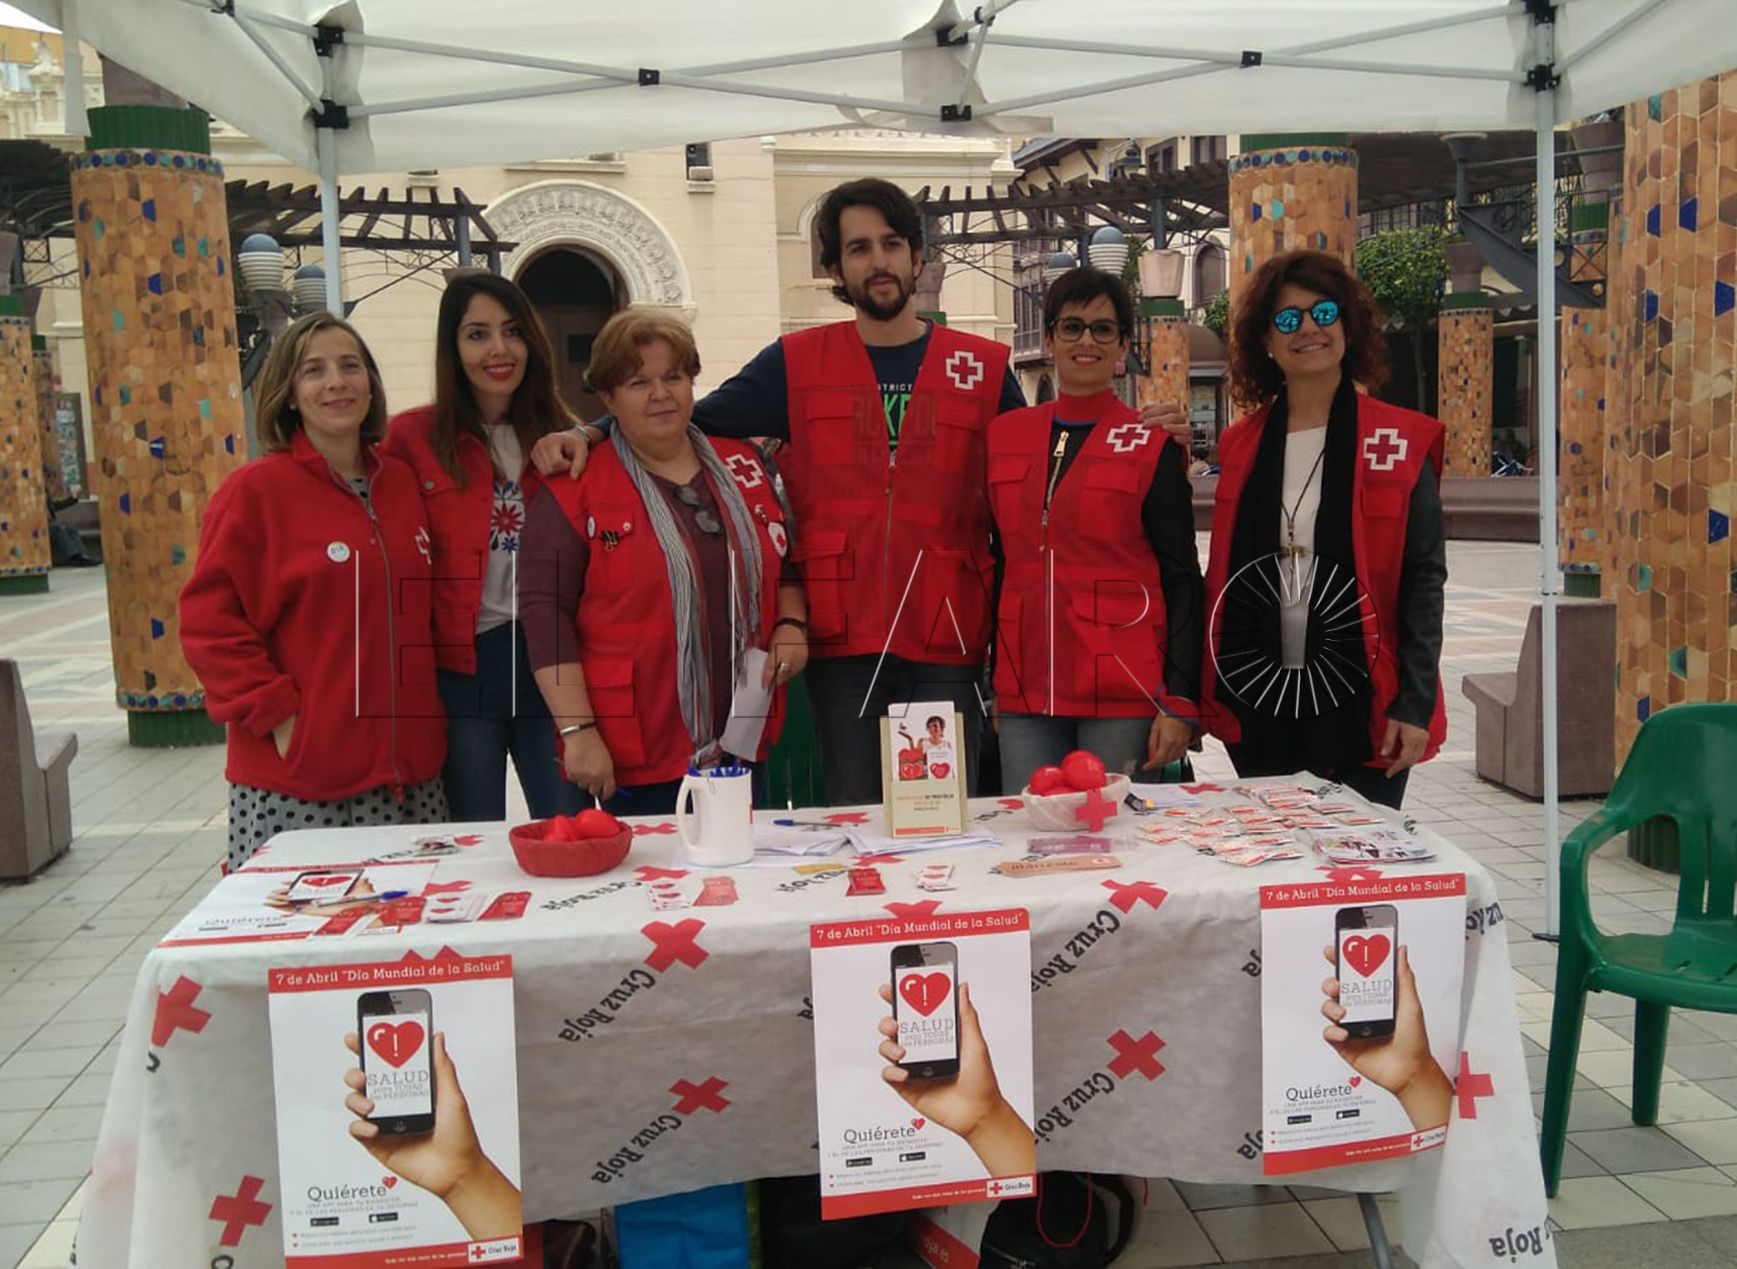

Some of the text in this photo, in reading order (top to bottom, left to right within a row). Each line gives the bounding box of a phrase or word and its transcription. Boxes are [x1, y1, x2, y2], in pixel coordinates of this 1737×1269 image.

[1266, 890, 1274, 901] 7
[1276, 890, 1290, 901] de
[1292, 887, 1319, 900] Abril
[1348, 882, 1393, 896] Mundial
[1395, 883, 1408, 893] de
[1411, 881, 1422, 892] la
[816, 928, 824, 940] 7
[827, 928, 842, 940] de
[844, 925, 873, 939] Abril
[904, 919, 951, 934] Mundial
[954, 919, 968, 929] de
[971, 917, 983, 928] la
[1063, 909, 1121, 959] Cruz
[275, 973, 285, 986] 7
[287, 974, 304, 985] de
[306, 971, 338, 984] Abril
[373, 963, 425, 980] Mundial
[429, 964, 444, 976] de
[448, 963, 460, 975] la
[1341, 978, 1393, 994] SALUD
[558, 968, 657, 1042] Cruz Roja
[900, 1018, 954, 1034] SALUD
[367, 1069, 429, 1086] SALUD
[1285, 1084, 1352, 1102] Quiérete
[1034, 1072, 1115, 1145] Cruz Roj
[843, 1126, 916, 1144] Quiérete
[590, 1114, 683, 1184] Cruz Roja
[307, 1184, 387, 1202] Quiérete
[1489, 1226, 1543, 1264] Roja
